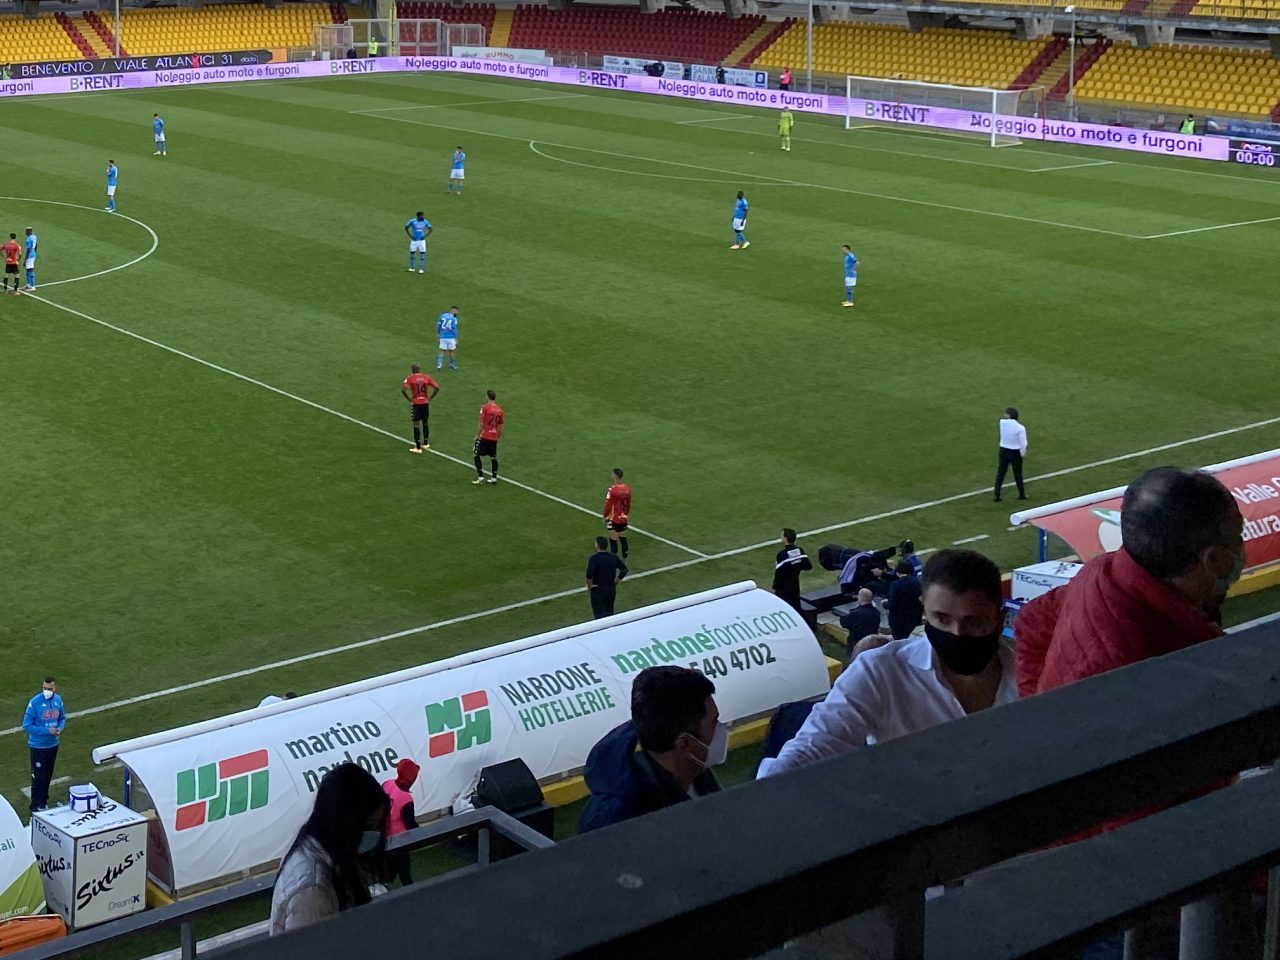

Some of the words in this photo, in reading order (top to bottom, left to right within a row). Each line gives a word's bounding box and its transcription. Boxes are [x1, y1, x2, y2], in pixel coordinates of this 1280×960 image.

[21, 61, 93, 77] BENEVENTO
[114, 58, 148, 71] VIALE
[155, 54, 215, 69] ATLANICI
[221, 53, 233, 64] 31
[155, 69, 200, 84] Noleggio
[203, 68, 225, 80] auto
[228, 66, 254, 78] moto
[266, 62, 300, 78] furgoni
[405, 57, 457, 71] Noleggio
[459, 60, 482, 70] auto
[483, 62, 507, 73] moto
[517, 64, 549, 78] furgoni
[658, 79, 706, 97] Noleggio
[709, 86, 735, 99] auto
[737, 89, 766, 104] moto
[770, 94, 777, 104] e
[780, 92, 823, 110] furgoni
[970, 113, 1036, 134] Noeggio
[1042, 121, 1076, 138] auto
[1081, 127, 1122, 143] moto
[1128, 134, 1137, 145] e
[1143, 134, 1202, 152] furgoni
[1236, 152, 1275, 166] 00:00
[441, 318, 453, 330] 24
[610, 609, 798, 674] nardoneforni.com
[730, 643, 776, 672] 4702
[500, 662, 603, 707] NARDONE
[518, 687, 616, 732] HOTELLERIE
[285, 719, 382, 760] martino
[302, 745, 399, 793] none
